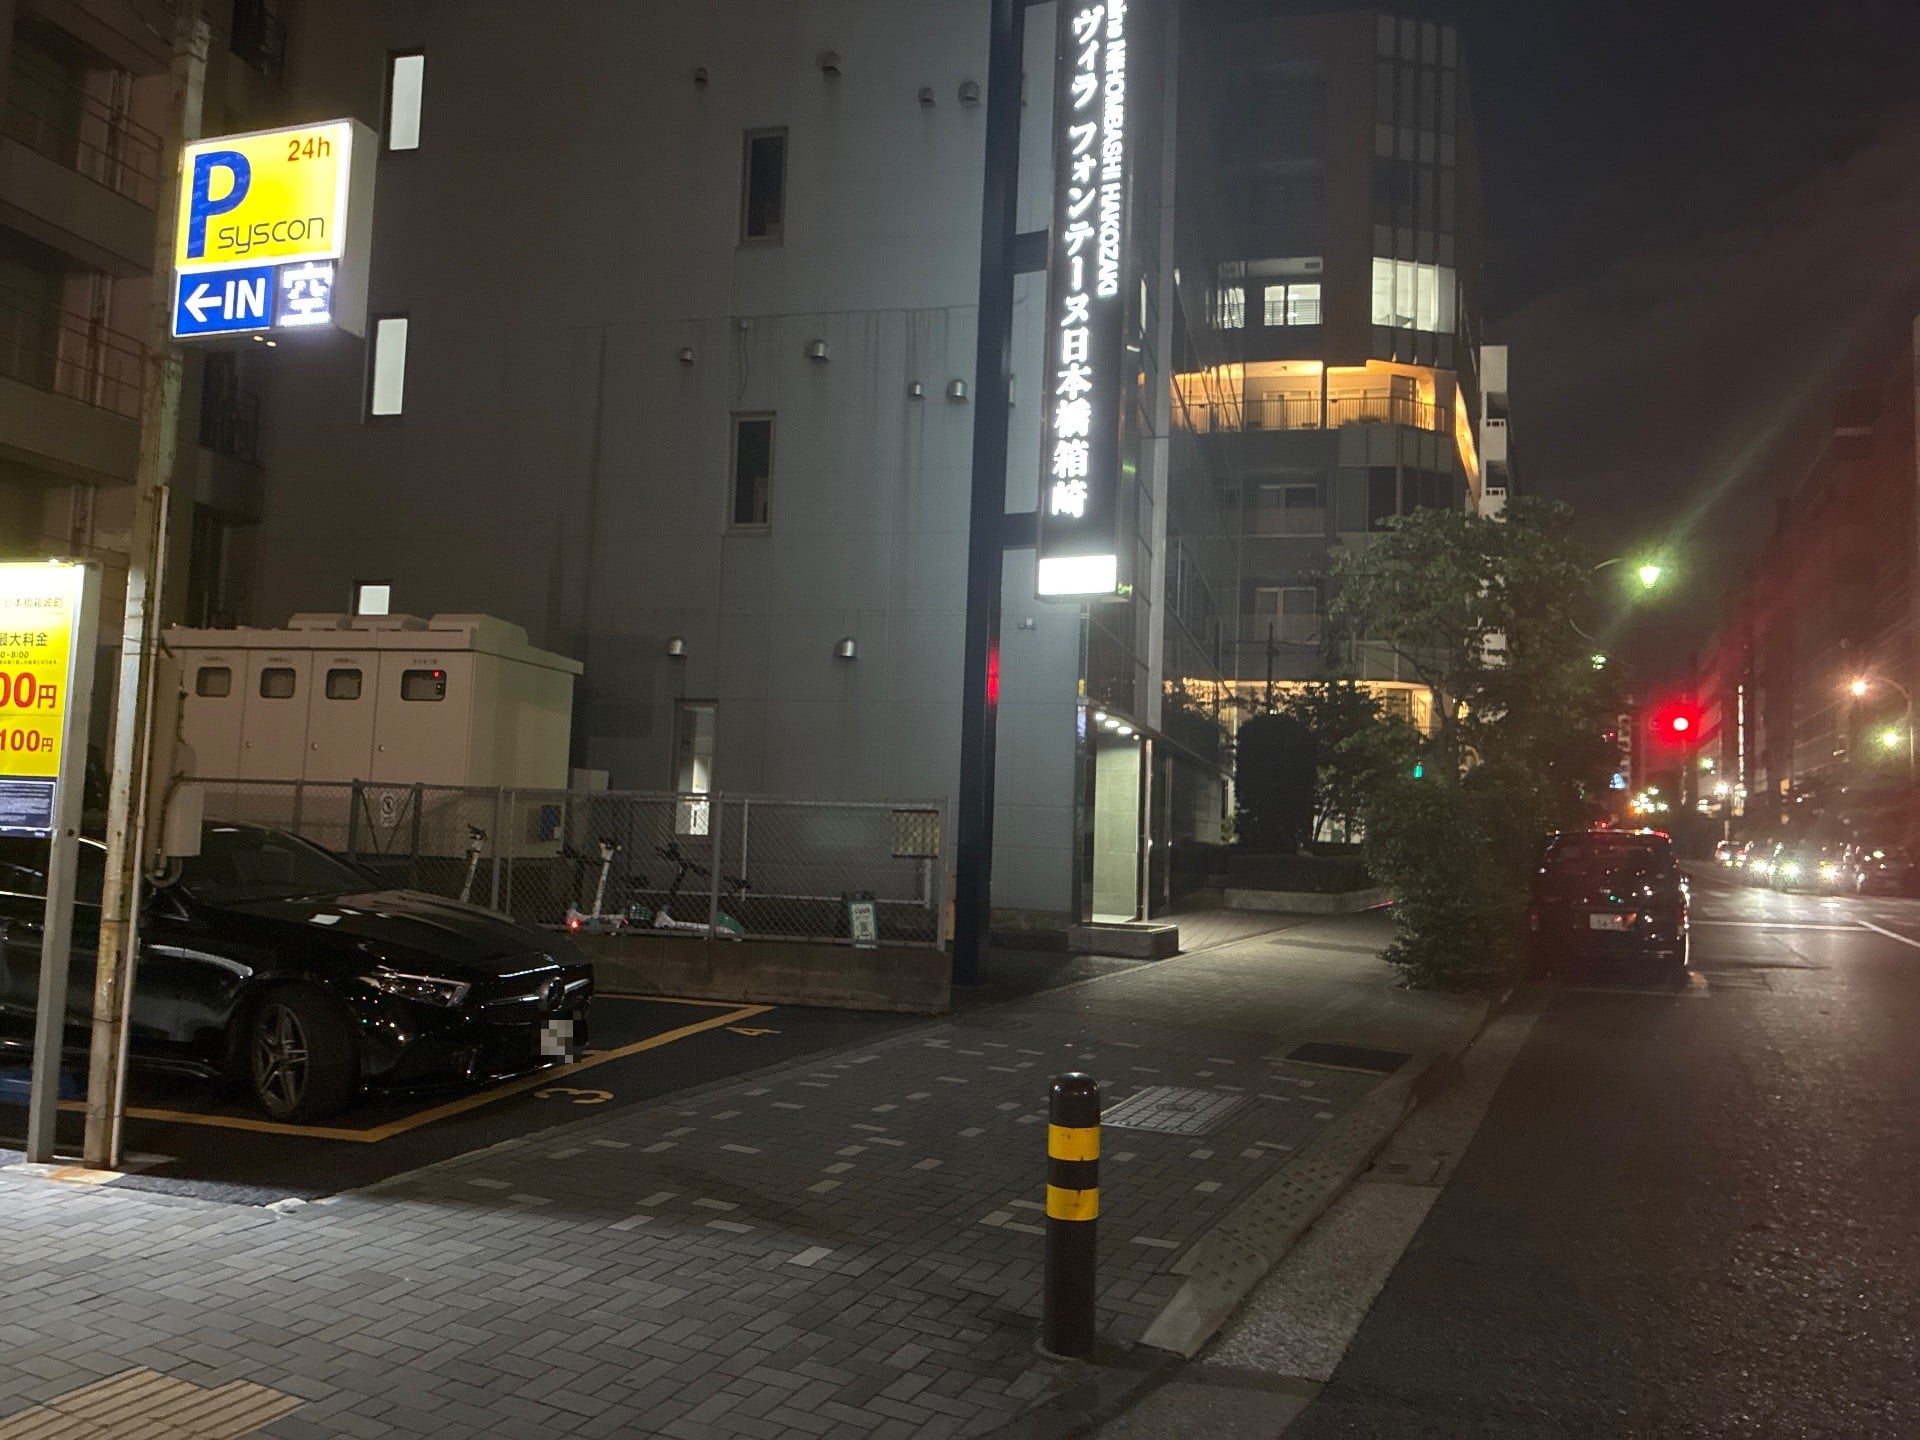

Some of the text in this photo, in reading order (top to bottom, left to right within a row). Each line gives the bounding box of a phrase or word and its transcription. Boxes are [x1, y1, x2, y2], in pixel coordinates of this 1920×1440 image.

[1071, 5, 1105, 109] ヴィラ
[288, 137, 330, 161] 24h
[1102, 39, 1126, 179] NIHONBASHI
[187, 150, 251, 259] P
[218, 217, 325, 254] syscon
[1097, 182, 1120, 297] HAKOZAKI
[224, 278, 265, 320] IN
[279, 262, 334, 327] 空
